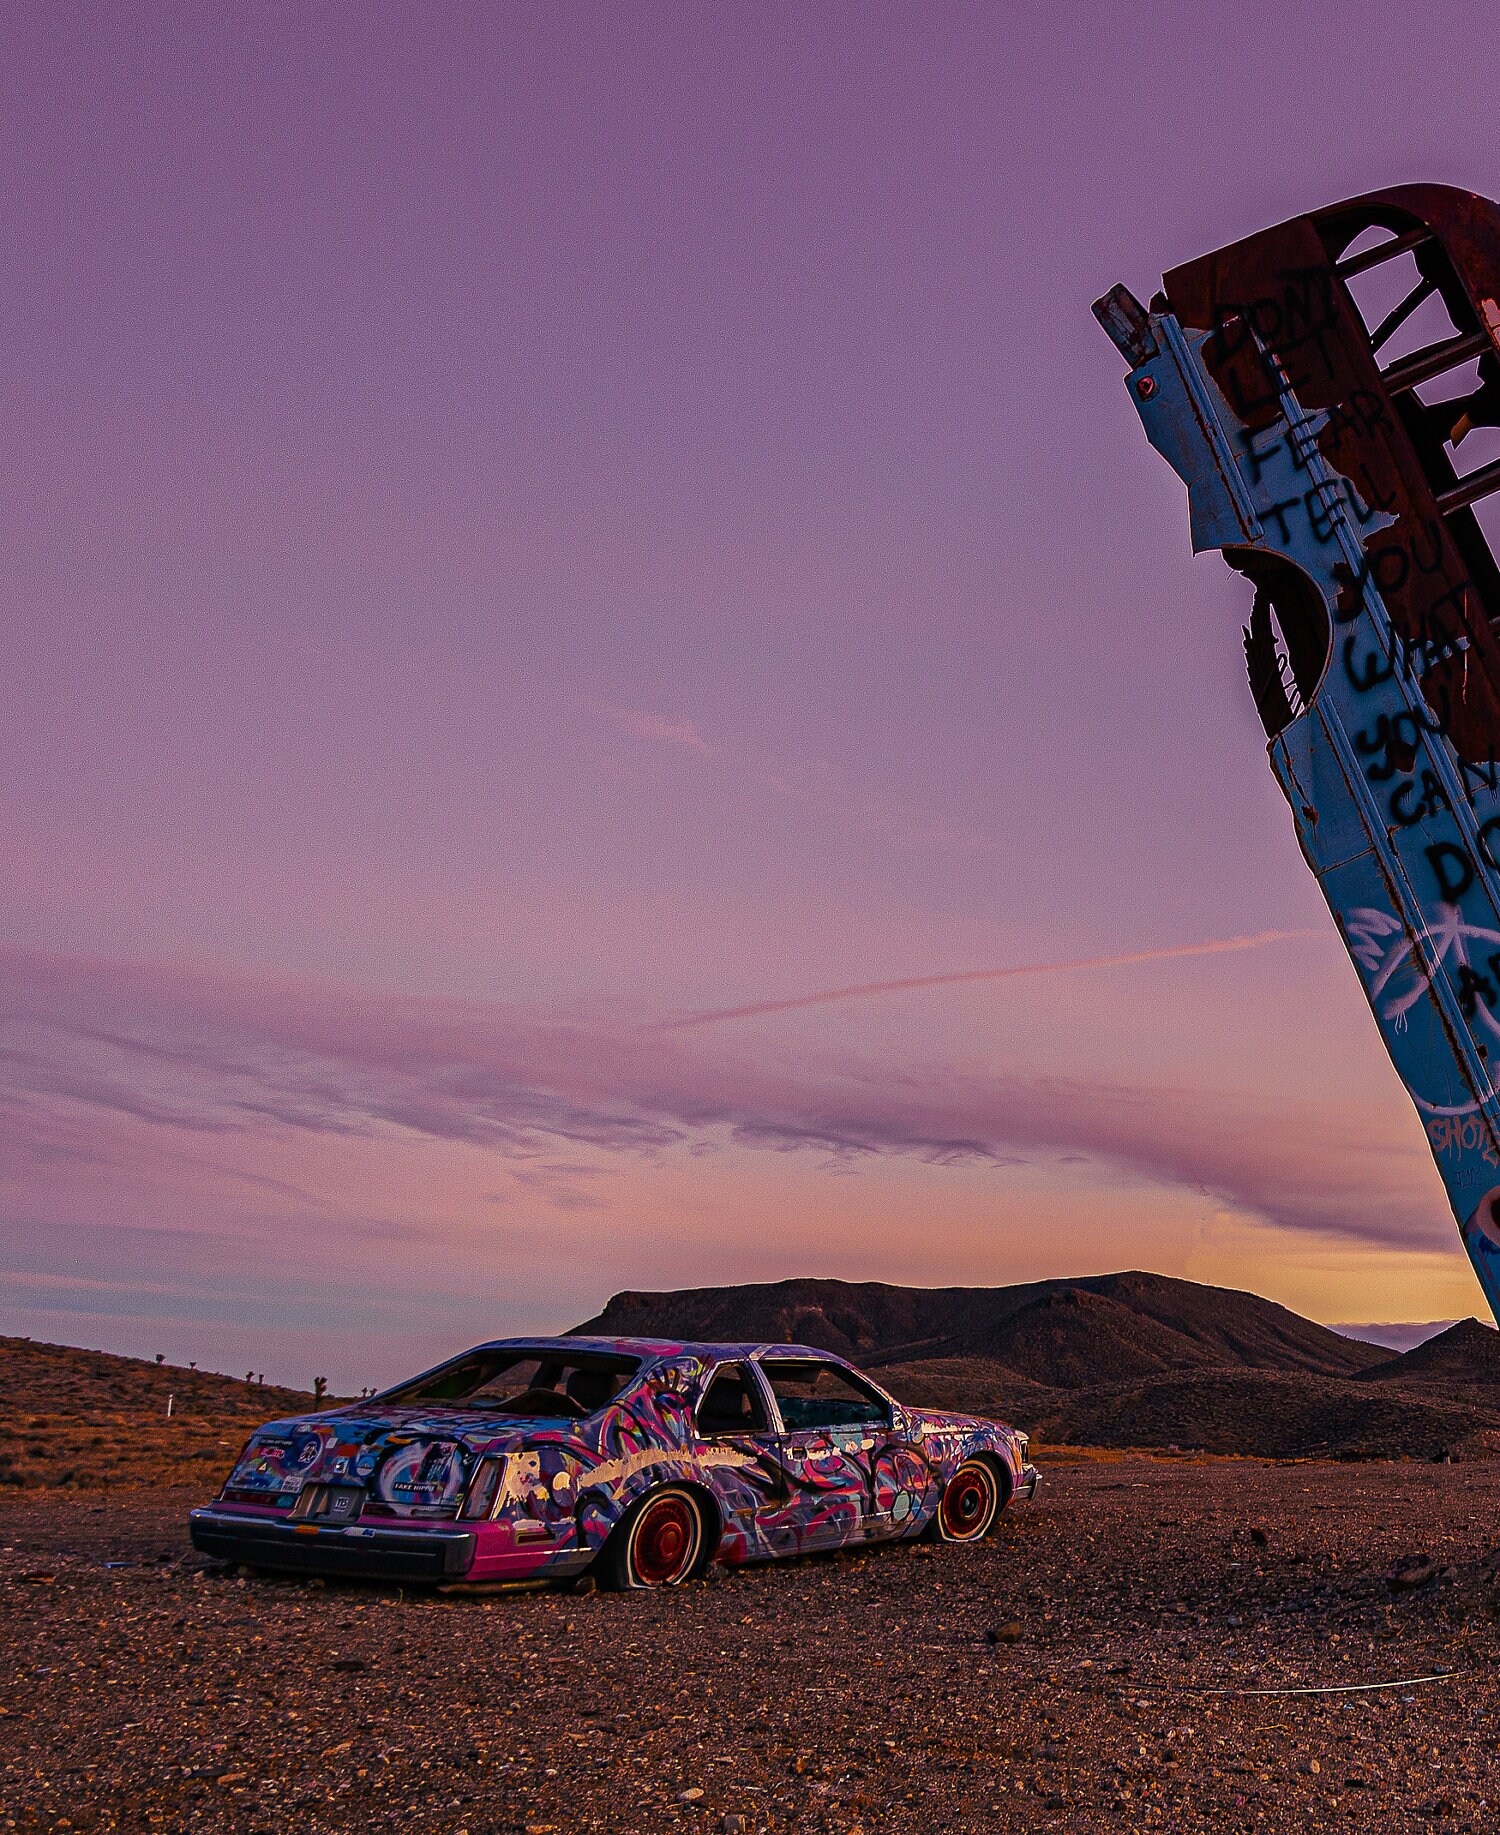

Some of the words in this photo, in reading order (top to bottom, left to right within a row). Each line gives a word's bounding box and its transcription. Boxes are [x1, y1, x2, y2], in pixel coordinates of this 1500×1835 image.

[1229, 312, 1339, 416] LET
[1239, 390, 1394, 485] FEAR
[1260, 463, 1396, 543] TELL
[1331, 521, 1442, 622] YOU
[1344, 579, 1485, 692] WHAT
[1390, 744, 1498, 825] CAN
[394, 1482, 412, 1491] FAKE
